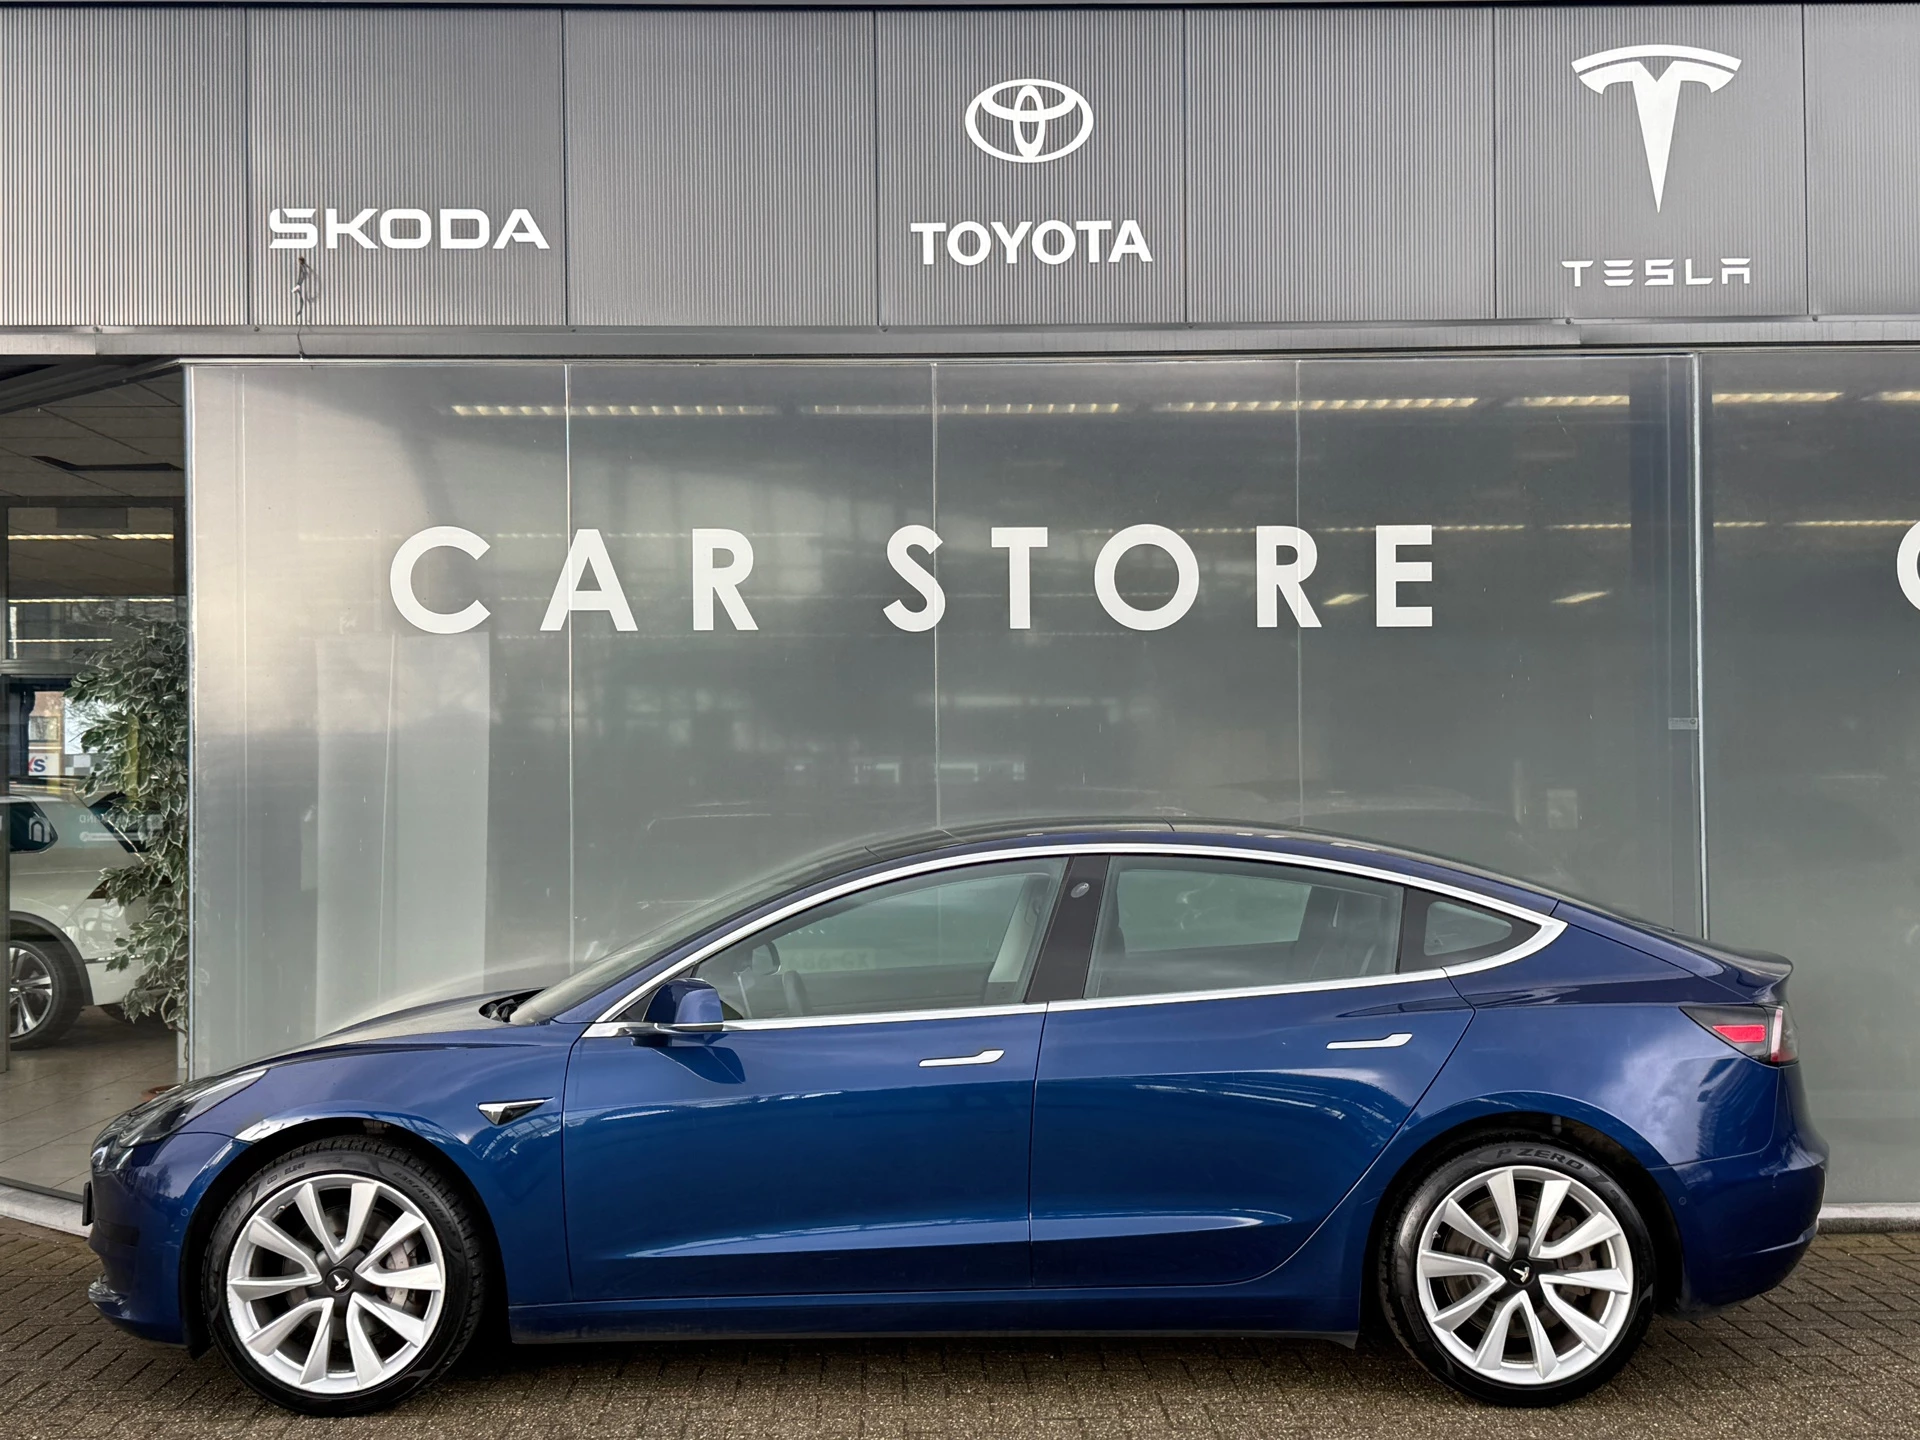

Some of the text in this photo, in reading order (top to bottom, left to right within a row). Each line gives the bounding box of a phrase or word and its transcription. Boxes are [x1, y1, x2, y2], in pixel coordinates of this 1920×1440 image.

[910, 219, 1153, 266] TOYOTA
[1561, 258, 1751, 288] TESLA
[389, 523, 1434, 633] CAR STORE
[1497, 1147, 1584, 1171] P ZERO
